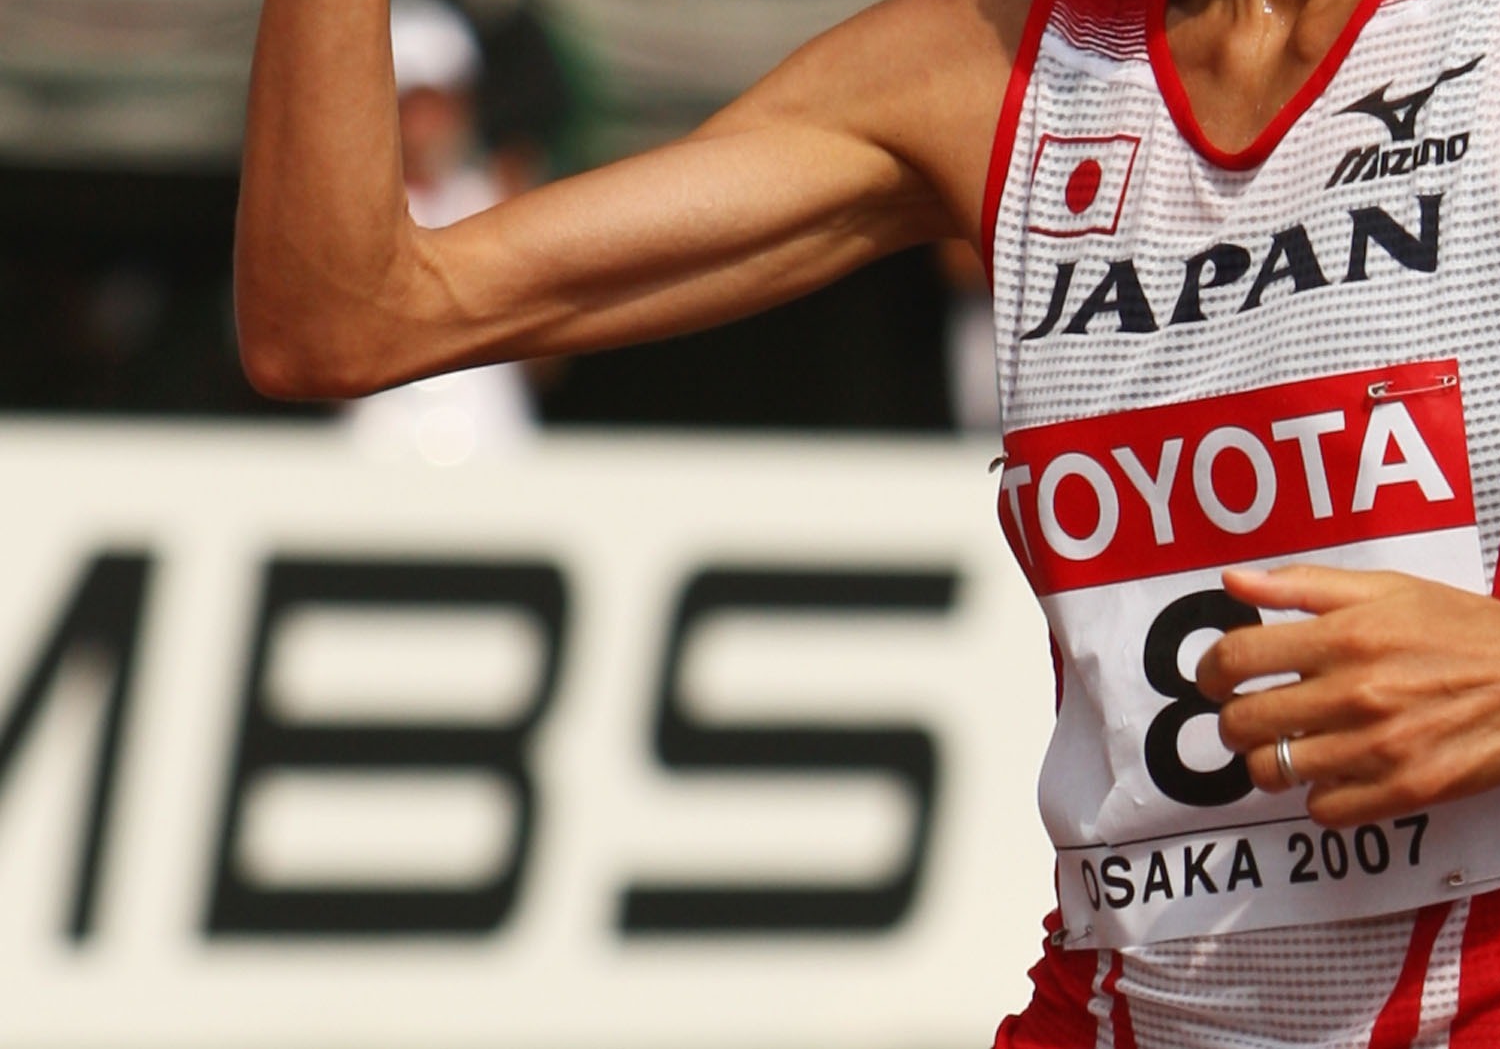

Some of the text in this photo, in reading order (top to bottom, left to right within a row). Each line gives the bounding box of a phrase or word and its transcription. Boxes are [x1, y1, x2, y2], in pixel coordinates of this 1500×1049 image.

[1020, 192, 1445, 339] JAPAN
[1001, 401, 1455, 566] TOYOTA
[1144, 588, 1265, 807] 8
[1081, 814, 1430, 911] OSAKA 2007
